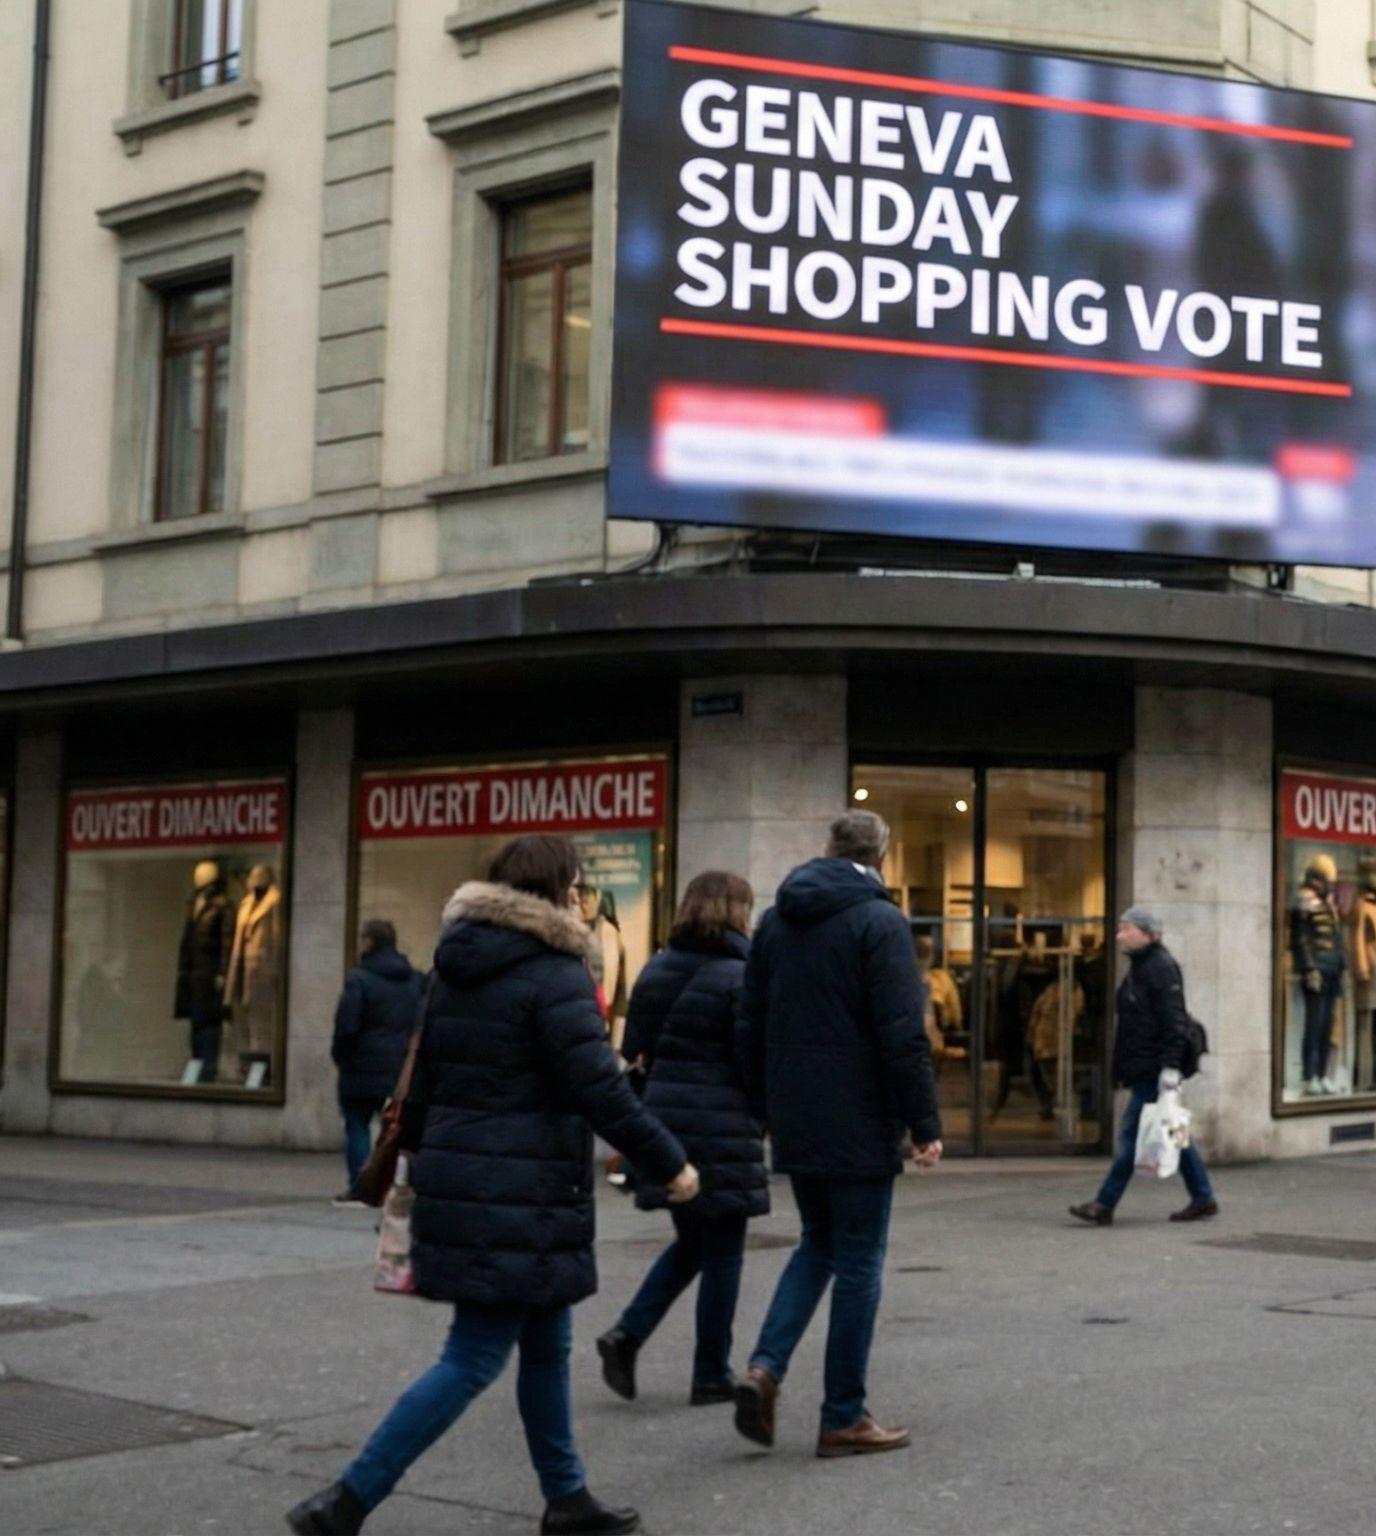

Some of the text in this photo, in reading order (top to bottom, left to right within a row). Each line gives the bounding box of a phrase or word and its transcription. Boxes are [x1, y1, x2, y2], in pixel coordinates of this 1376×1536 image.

[680, 78, 1013, 184] GENEVA
[677, 156, 1019, 258] SUNDAY
[672, 236, 1323, 368] SHOPPING VOTE
[71, 790, 280, 841] OUVERT DIMANCHE
[367, 771, 656, 830] OUVERT DIMANCHE
